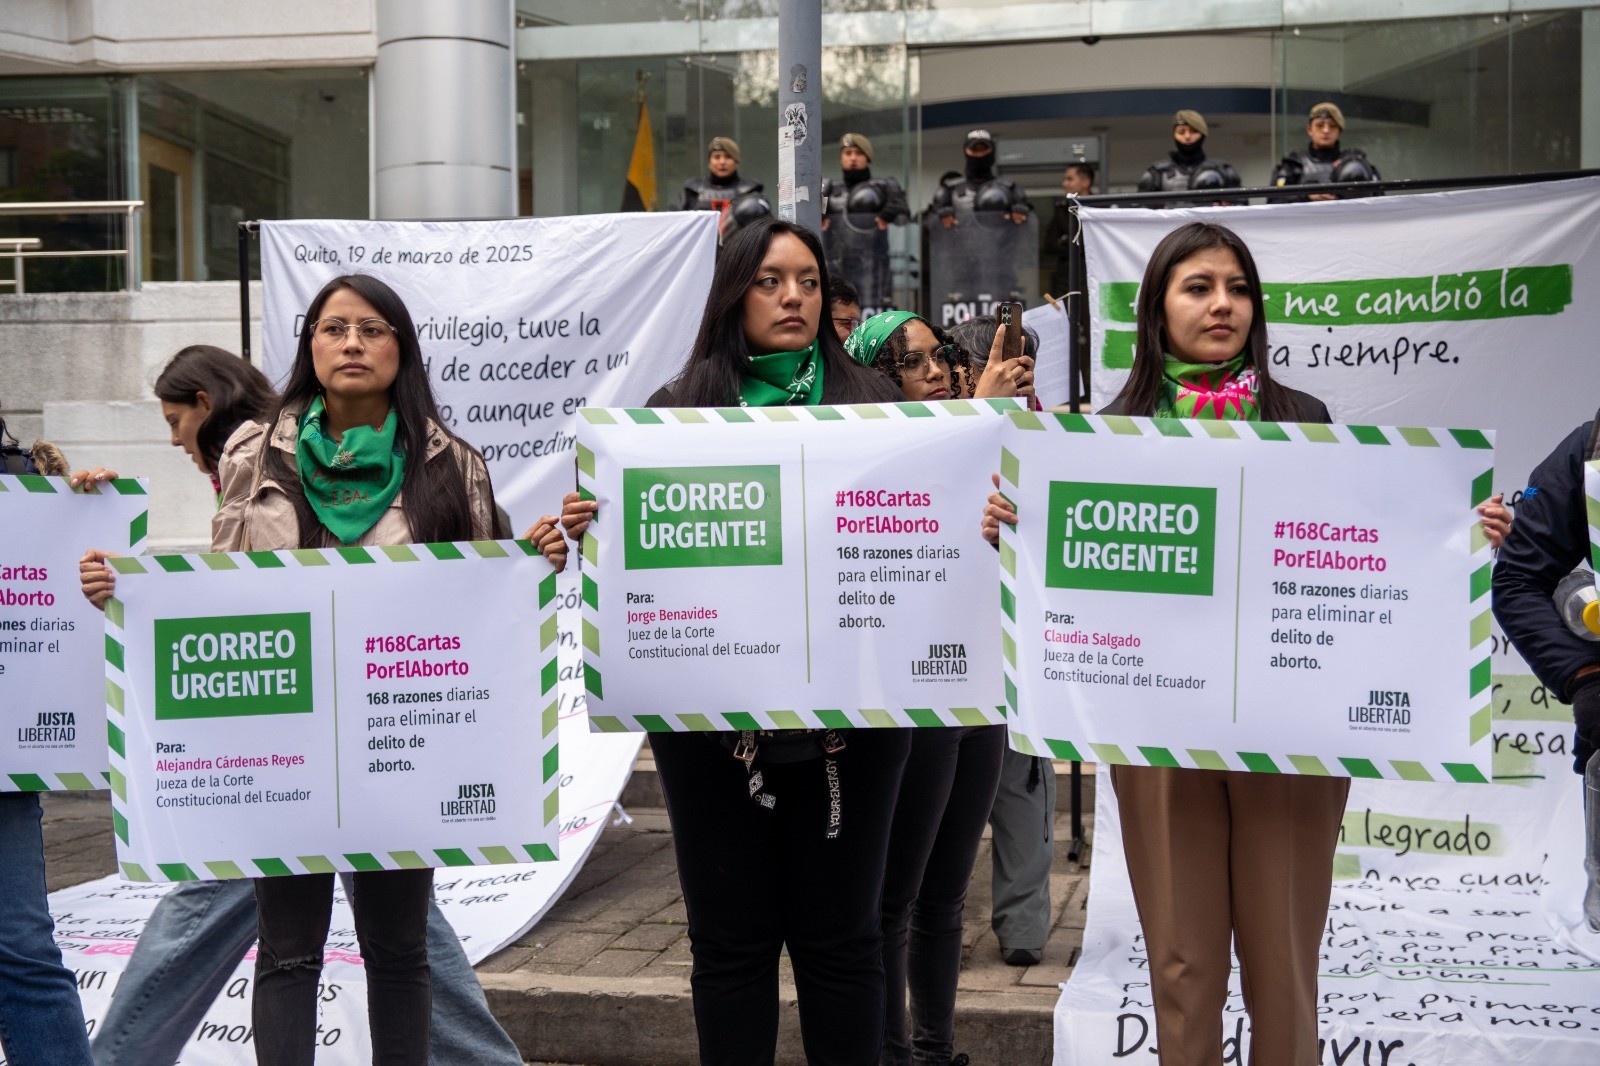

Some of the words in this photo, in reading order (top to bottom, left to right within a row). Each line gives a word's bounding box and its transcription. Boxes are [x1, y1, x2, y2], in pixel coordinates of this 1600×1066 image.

[294, 244, 341, 265] Quito,
[350, 245, 365, 262] 19
[372, 248, 392, 264] de
[398, 250, 452, 264] marzo
[460, 247, 479, 264] de
[486, 245, 532, 262] 2025
[1284, 291, 1340, 318] me
[1355, 273, 1482, 317] cambió
[1498, 268, 1529, 309] la
[416, 316, 508, 346] rivilegio,
[518, 317, 569, 339] tuve
[580, 312, 600, 336] la
[1307, 327, 1460, 374] siempre.
[442, 357, 469, 381] de
[480, 354, 575, 380] acceder
[585, 359, 597, 375] a
[607, 351, 629, 370] un
[467, 401, 553, 426] aunque
[319, 489, 372, 507] LEGAL
[640, 481, 765, 520] ¡CORREO
[836, 490, 930, 507] #168Cartas
[837, 516, 939, 533] PorElAborto
[1066, 500, 1199, 537] ¡CORREO
[640, 521, 766, 549] URGENTE!
[1274, 521, 1378, 543] #168Cartas
[837, 547, 859, 559] 168
[863, 548, 912, 559] razones
[917, 545, 960, 559] diarias
[1063, 540, 1197, 574] URGENTE!
[1274, 549, 1386, 572] PorElAborto
[0, 564, 47, 581] artas
[838, 570, 865, 585] para
[870, 566, 930, 582] eliminar
[935, 568, 946, 581] el
[627, 592, 654, 604] Para:
[839, 591, 875, 605] delito
[879, 591, 895, 605] de
[1272, 582, 1296, 595] 168
[1301, 584, 1355, 598] razones
[1360, 584, 1408, 601] diarias
[627, 610, 655, 624] Jorge
[659, 607, 717, 621] Benavides
[839, 614, 885, 628] aborto.
[1045, 611, 1074, 624] Para:
[1272, 607, 1302, 622] para
[1307, 604, 1375, 623] eliminar
[1379, 610, 1392, 624] el
[31, 618, 75, 631] diarias
[628, 628, 650, 642] Juez
[654, 627, 667, 639] de
[671, 627, 681, 638] la
[685, 626, 715, 638] Corte
[1045, 630, 1088, 644] Claudia
[1092, 633, 1140, 649] Salgado
[1271, 629, 1311, 645] delito
[1316, 631, 1334, 645] de
[48, 639, 59, 652] el
[172, 629, 295, 671] ¡CORREO
[366, 635, 460, 653] #168Cartas
[629, 644, 709, 659] Constitucional
[713, 643, 730, 656] del
[734, 642, 780, 654] Ecuador
[929, 644, 966, 659] JUSTA
[1044, 649, 1074, 662] Jueza
[1079, 651, 1093, 664] de
[1098, 652, 1107, 665] la
[1112, 653, 1144, 666] Corte
[1270, 653, 1321, 670] aborto.
[366, 659, 469, 679] PorElAborto
[911, 660, 967, 675] LIBERTAD
[171, 669, 296, 700] URGENTE!
[1044, 668, 1129, 686] Constitucional
[1133, 673, 1151, 686] del
[1156, 675, 1205, 689] Ecuador
[367, 692, 389, 705] 168
[393, 691, 442, 704] razones
[447, 686, 490, 701] diarias
[1368, 691, 1410, 707] JUSTA
[36, 712, 75, 726] JUSTA
[368, 714, 395, 730] para
[400, 709, 460, 726] eliminar
[465, 709, 476, 723] el
[1349, 707, 1411, 725] LIBERTAD
[19, 728, 75, 741] LIBERTAD
[368, 736, 405, 750] delito
[409, 735, 425, 748] de
[156, 742, 185, 753] Para:
[156, 759, 212, 773] Alejandra
[216, 755, 268, 769] Cárdenas
[272, 754, 304, 768] Reyes
[369, 759, 415, 773] aborto.
[156, 779, 187, 791] Jueza
[192, 777, 205, 787] de
[209, 775, 219, 787] la
[224, 775, 254, 786] Corte
[458, 784, 495, 799] JUSTA
[156, 792, 241, 808] Constitucional
[245, 791, 262, 803] del
[266, 789, 311, 802] Ecuador
[441, 799, 496, 816] LIBERTAD
[1365, 808, 1491, 856] legrado
[464, 869, 537, 889] recae
[459, 891, 509, 907] que
[226, 977, 249, 999] a
[1323, 992, 1394, 1004] por
[1382, 1010, 1464, 1023] era
